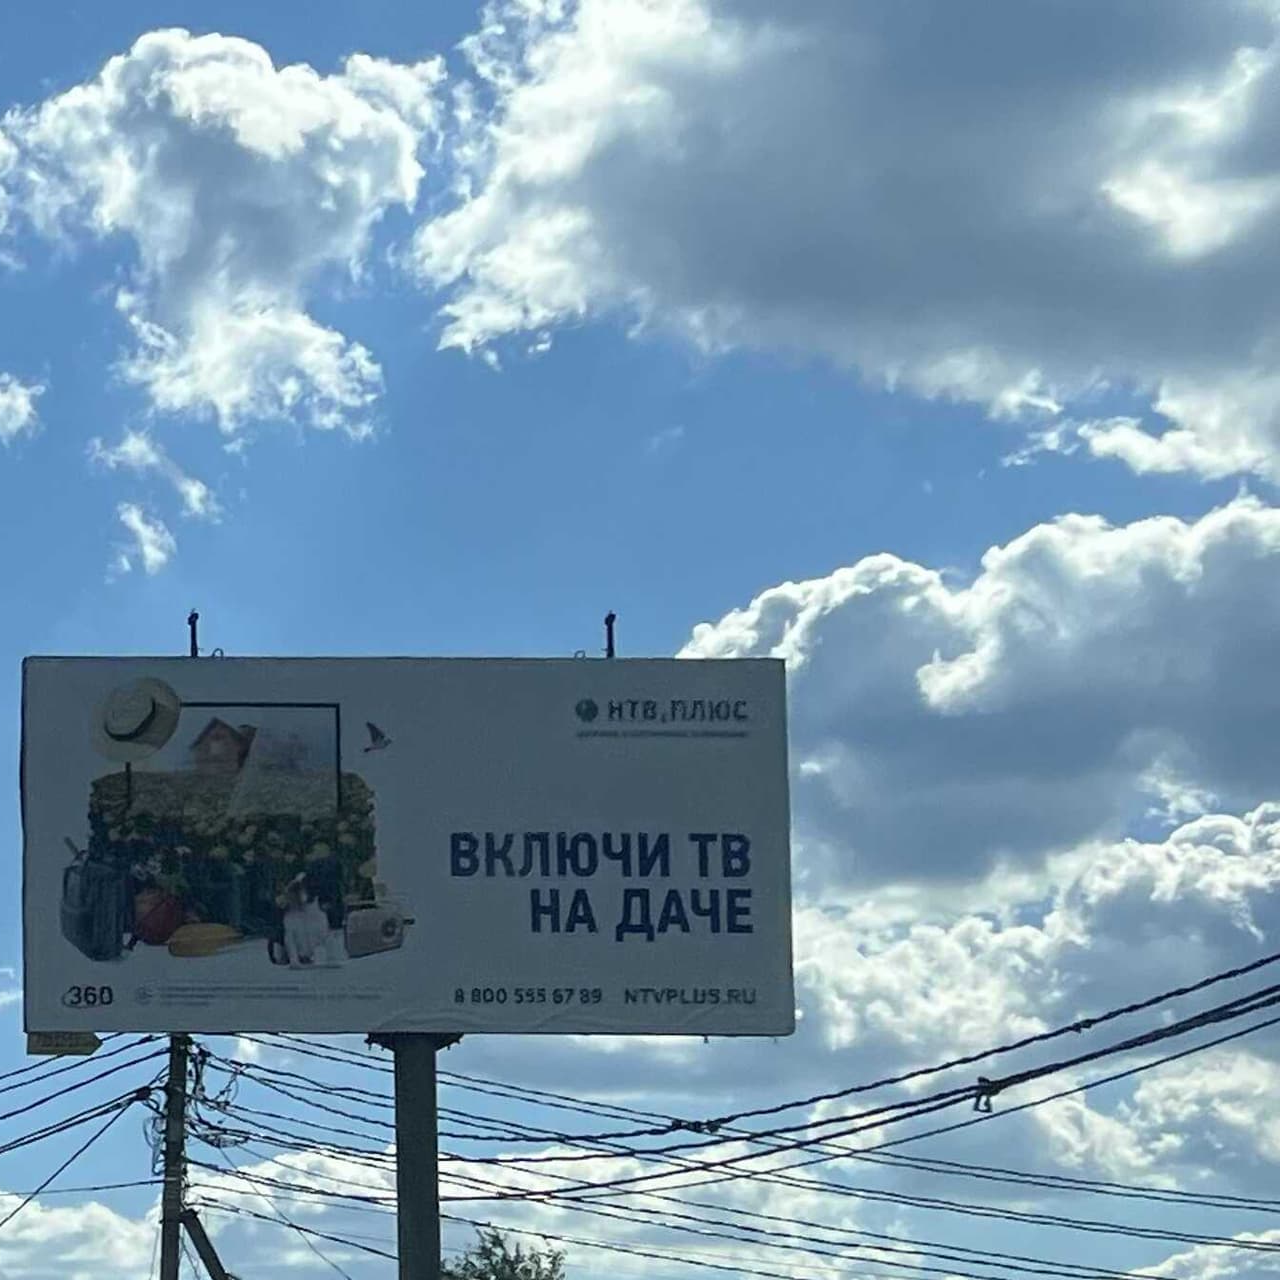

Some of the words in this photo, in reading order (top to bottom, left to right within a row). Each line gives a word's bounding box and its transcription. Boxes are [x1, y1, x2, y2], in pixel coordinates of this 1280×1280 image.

[449, 831, 671, 878] ВКЛЮЧИ
[688, 832, 752, 878] ТВ
[529, 887, 598, 934] НА
[615, 887, 754, 943] ДАЧЕ
[68, 985, 115, 1006] 360
[454, 988, 465, 1004] 8
[471, 988, 508, 1004] 800
[513, 988, 547, 1004] 555
[552, 988, 575, 1004] 67
[624, 988, 757, 1005] NTVPLUS.RU
